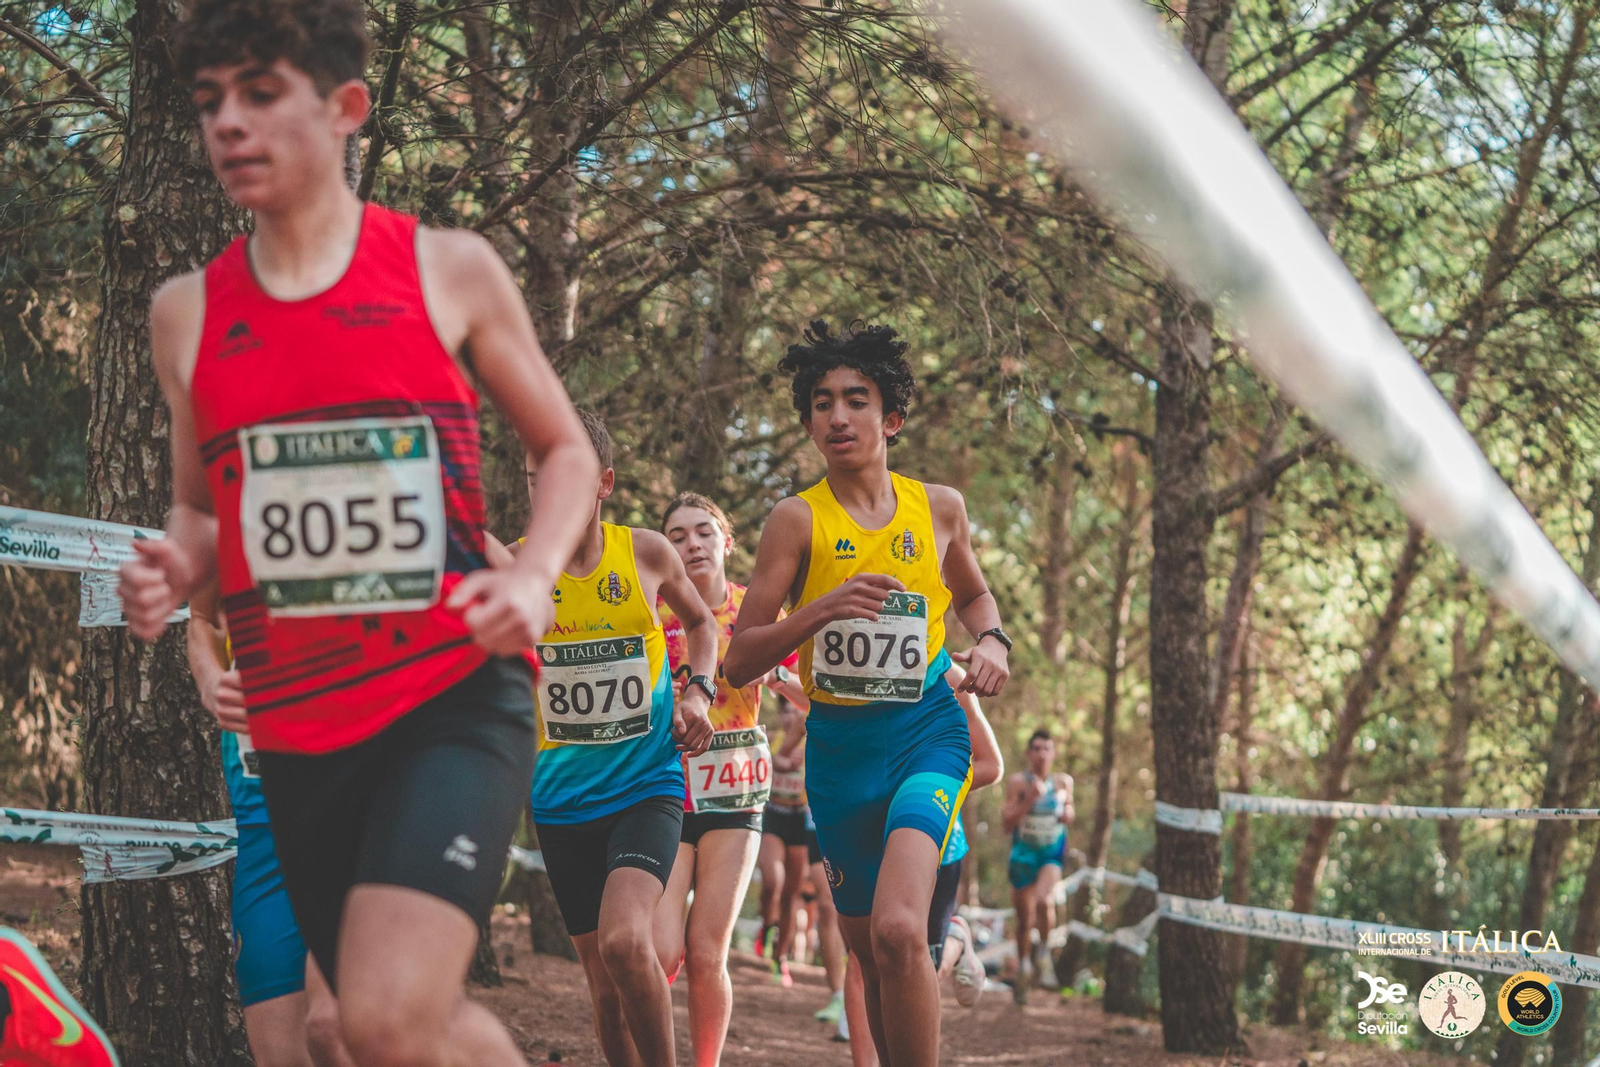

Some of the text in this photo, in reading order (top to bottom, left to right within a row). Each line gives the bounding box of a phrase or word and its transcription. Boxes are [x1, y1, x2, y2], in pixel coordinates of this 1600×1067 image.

[262, 494, 427, 559] 8055
[0, 535, 60, 560] Sevilla
[552, 617, 616, 636] Andalucía
[563, 643, 618, 660] ITÁLICA
[824, 630, 922, 670] 8076
[547, 675, 645, 716] 8070
[698, 757, 769, 791] 7440
